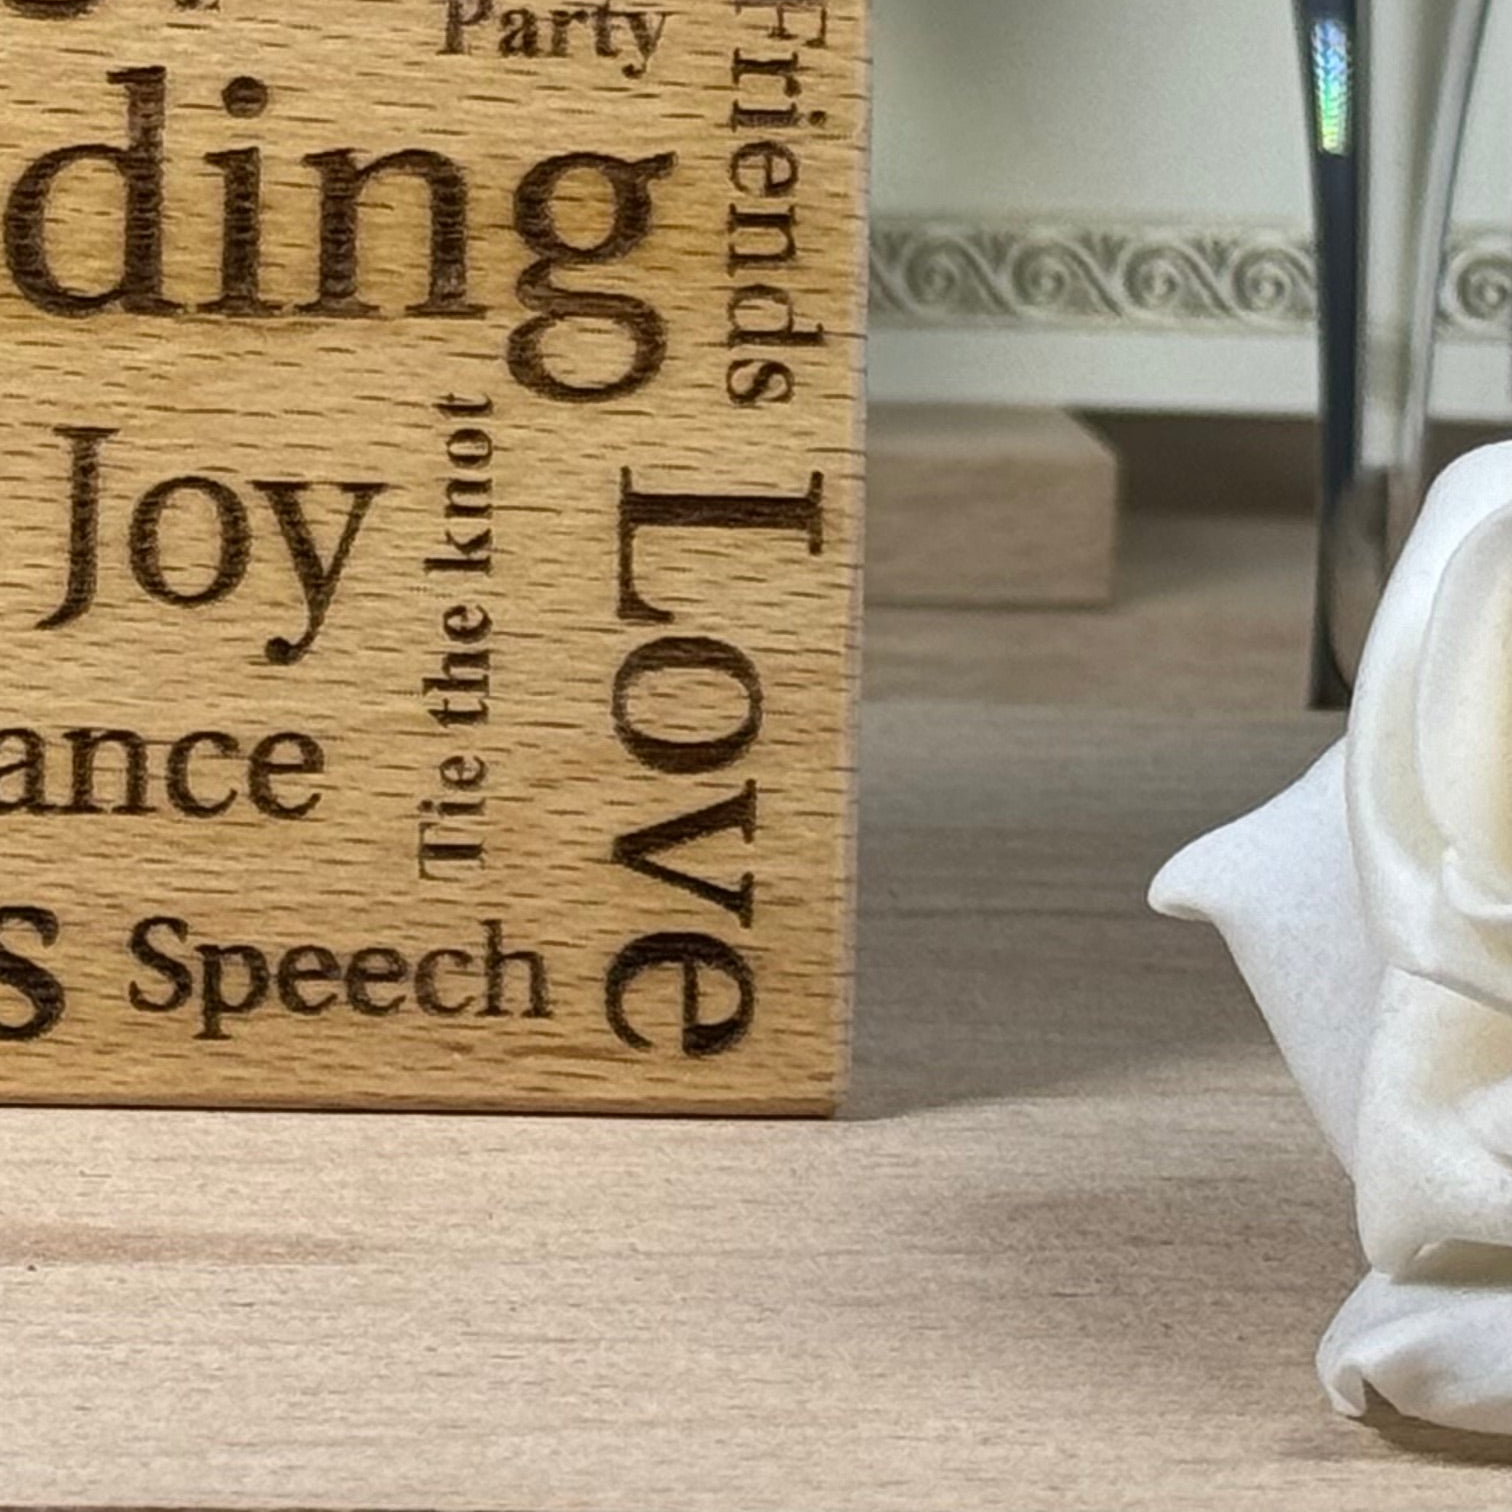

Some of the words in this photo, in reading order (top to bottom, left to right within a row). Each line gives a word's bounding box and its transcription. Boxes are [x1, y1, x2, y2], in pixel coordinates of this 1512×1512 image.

[34, 425, 390, 666] Joy
[424, 392, 495, 575] knot
[421, 602, 492, 730] the
[417, 752, 488, 881] Tie
[604, 464, 826, 1059] Love
[127, 914, 555, 1042] Speech
